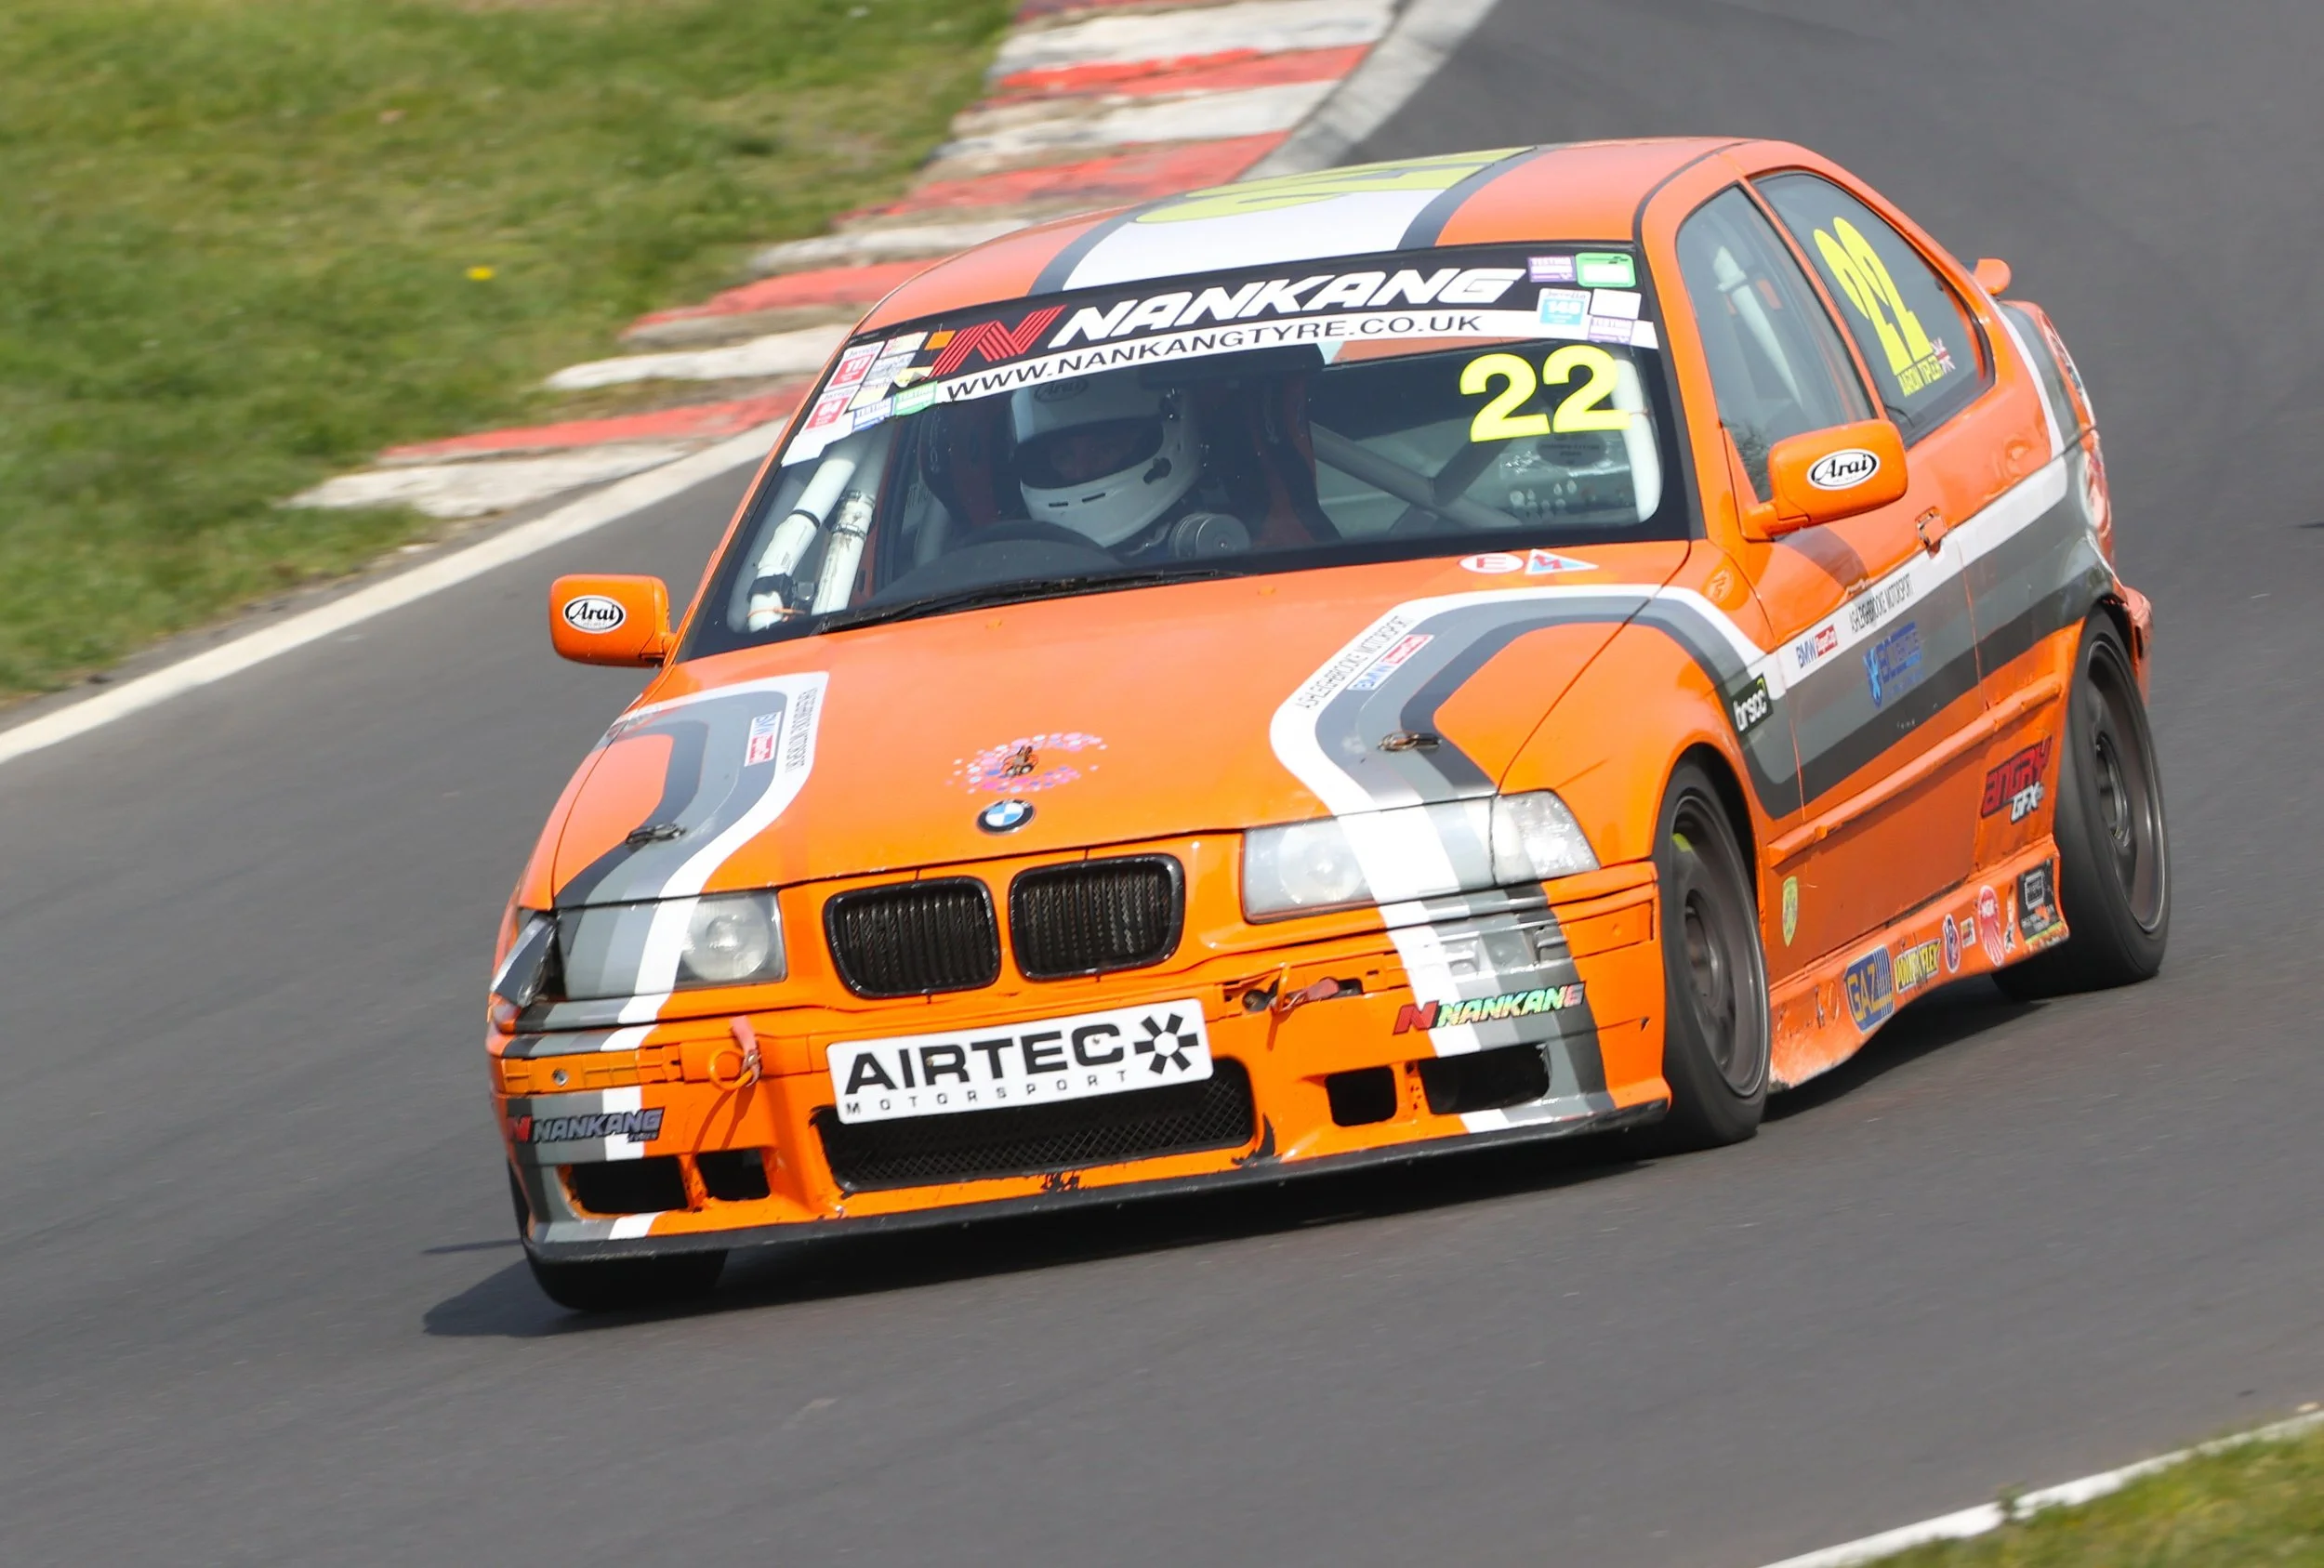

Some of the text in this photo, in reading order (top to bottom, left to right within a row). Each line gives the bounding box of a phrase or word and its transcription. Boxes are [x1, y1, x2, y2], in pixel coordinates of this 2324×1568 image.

[1048, 268, 1526, 349] NANKANG
[1814, 217, 1933, 376] 22
[946, 314, 1483, 400] WWW.NANKANGTYRE.CO.UK
[1459, 345, 1631, 442] 22
[1816, 454, 1868, 481] Arai
[570, 601, 615, 620] Arai
[1438, 982, 1585, 1027] NANKANG
[1847, 962, 1894, 1021] GAZ
[845, 1023, 1125, 1095] AIRTEC
[847, 1071, 1127, 1114] MOTORSPORT
[534, 1108, 664, 1142] NANKANG
